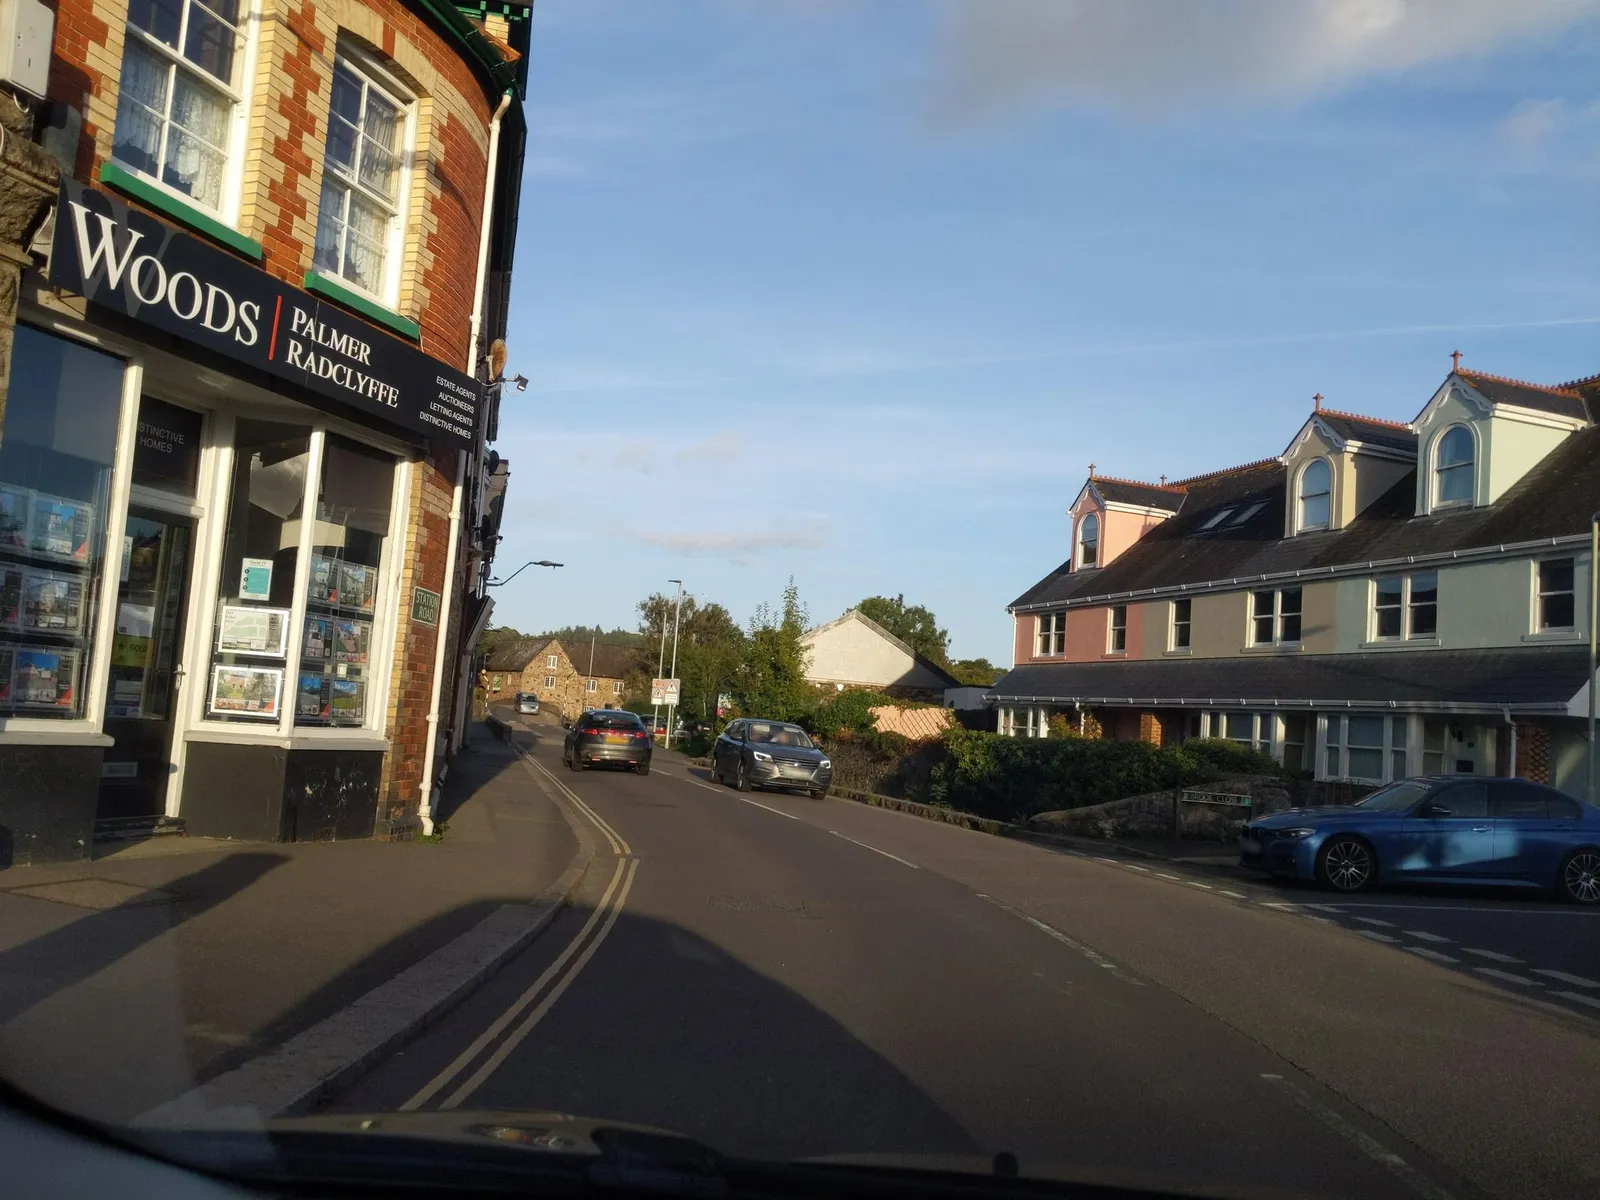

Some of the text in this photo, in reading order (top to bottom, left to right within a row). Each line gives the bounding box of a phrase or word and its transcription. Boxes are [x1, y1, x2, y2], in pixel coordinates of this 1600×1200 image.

[68, 201, 260, 346] WOODS
[290, 306, 371, 366] PALMER
[285, 338, 399, 408] RADCLYFFE
[436, 375, 476, 401] ESTATE AGENTS
[429, 401, 473, 427] LETTING AGENTS
[438, 391, 475, 414] AUCTIONEERS
[139, 422, 185, 445] STINCTIVE
[419, 411, 472, 440] DISTINCTIVE HOMES
[139, 436, 173, 453] HOMES
[416, 591, 438, 608] STATION
[418, 605, 434, 620] ROAD
[130, 643, 148, 653] GOLD
